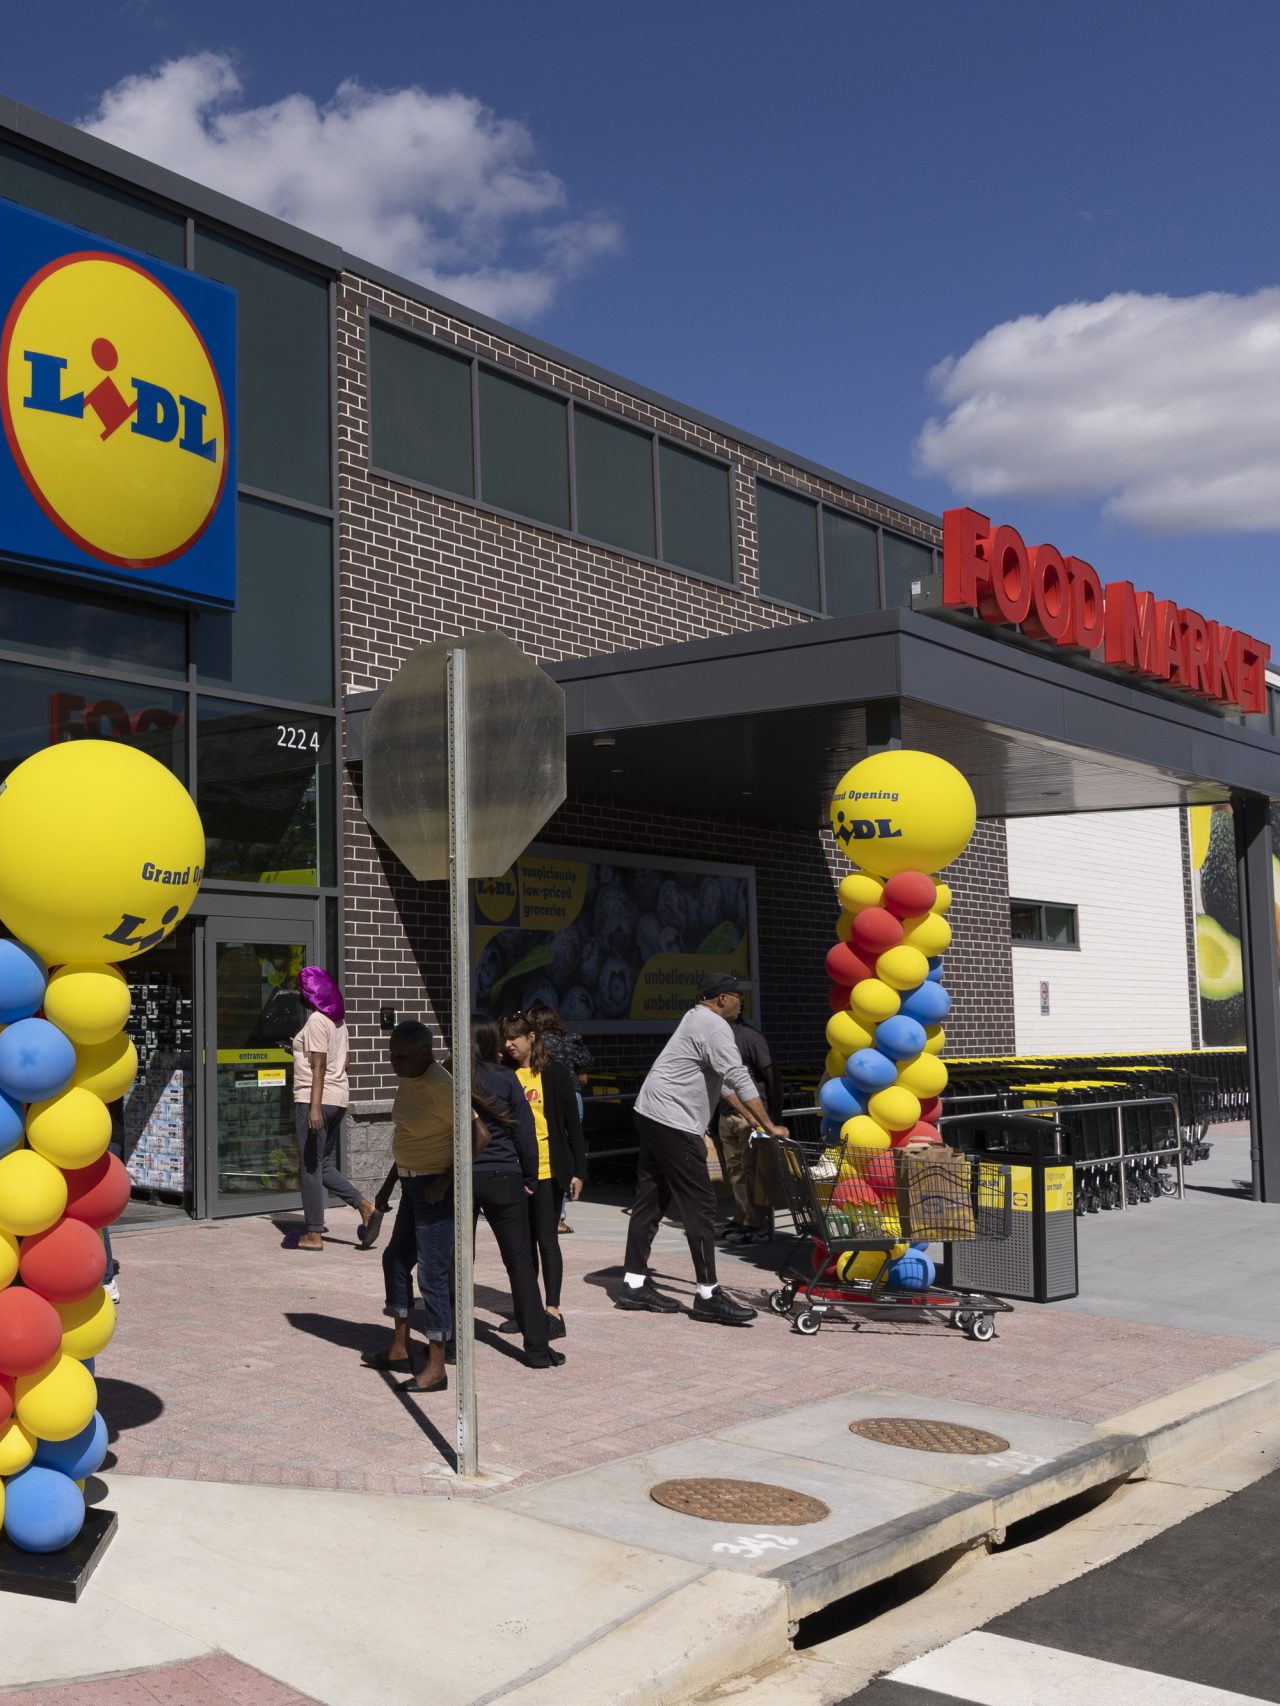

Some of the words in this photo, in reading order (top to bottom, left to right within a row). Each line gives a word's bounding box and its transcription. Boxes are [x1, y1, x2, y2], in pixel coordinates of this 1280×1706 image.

[943, 507, 1105, 650] FOOD
[1105, 580, 1271, 715] MARKET
[277, 725, 320, 752] 2224
[849, 790, 899, 802] Opening
[142, 862, 190, 885] Grand
[522, 866, 576, 884] suspiciously
[523, 883, 572, 900] low-priced
[524, 903, 566, 918] groceries
